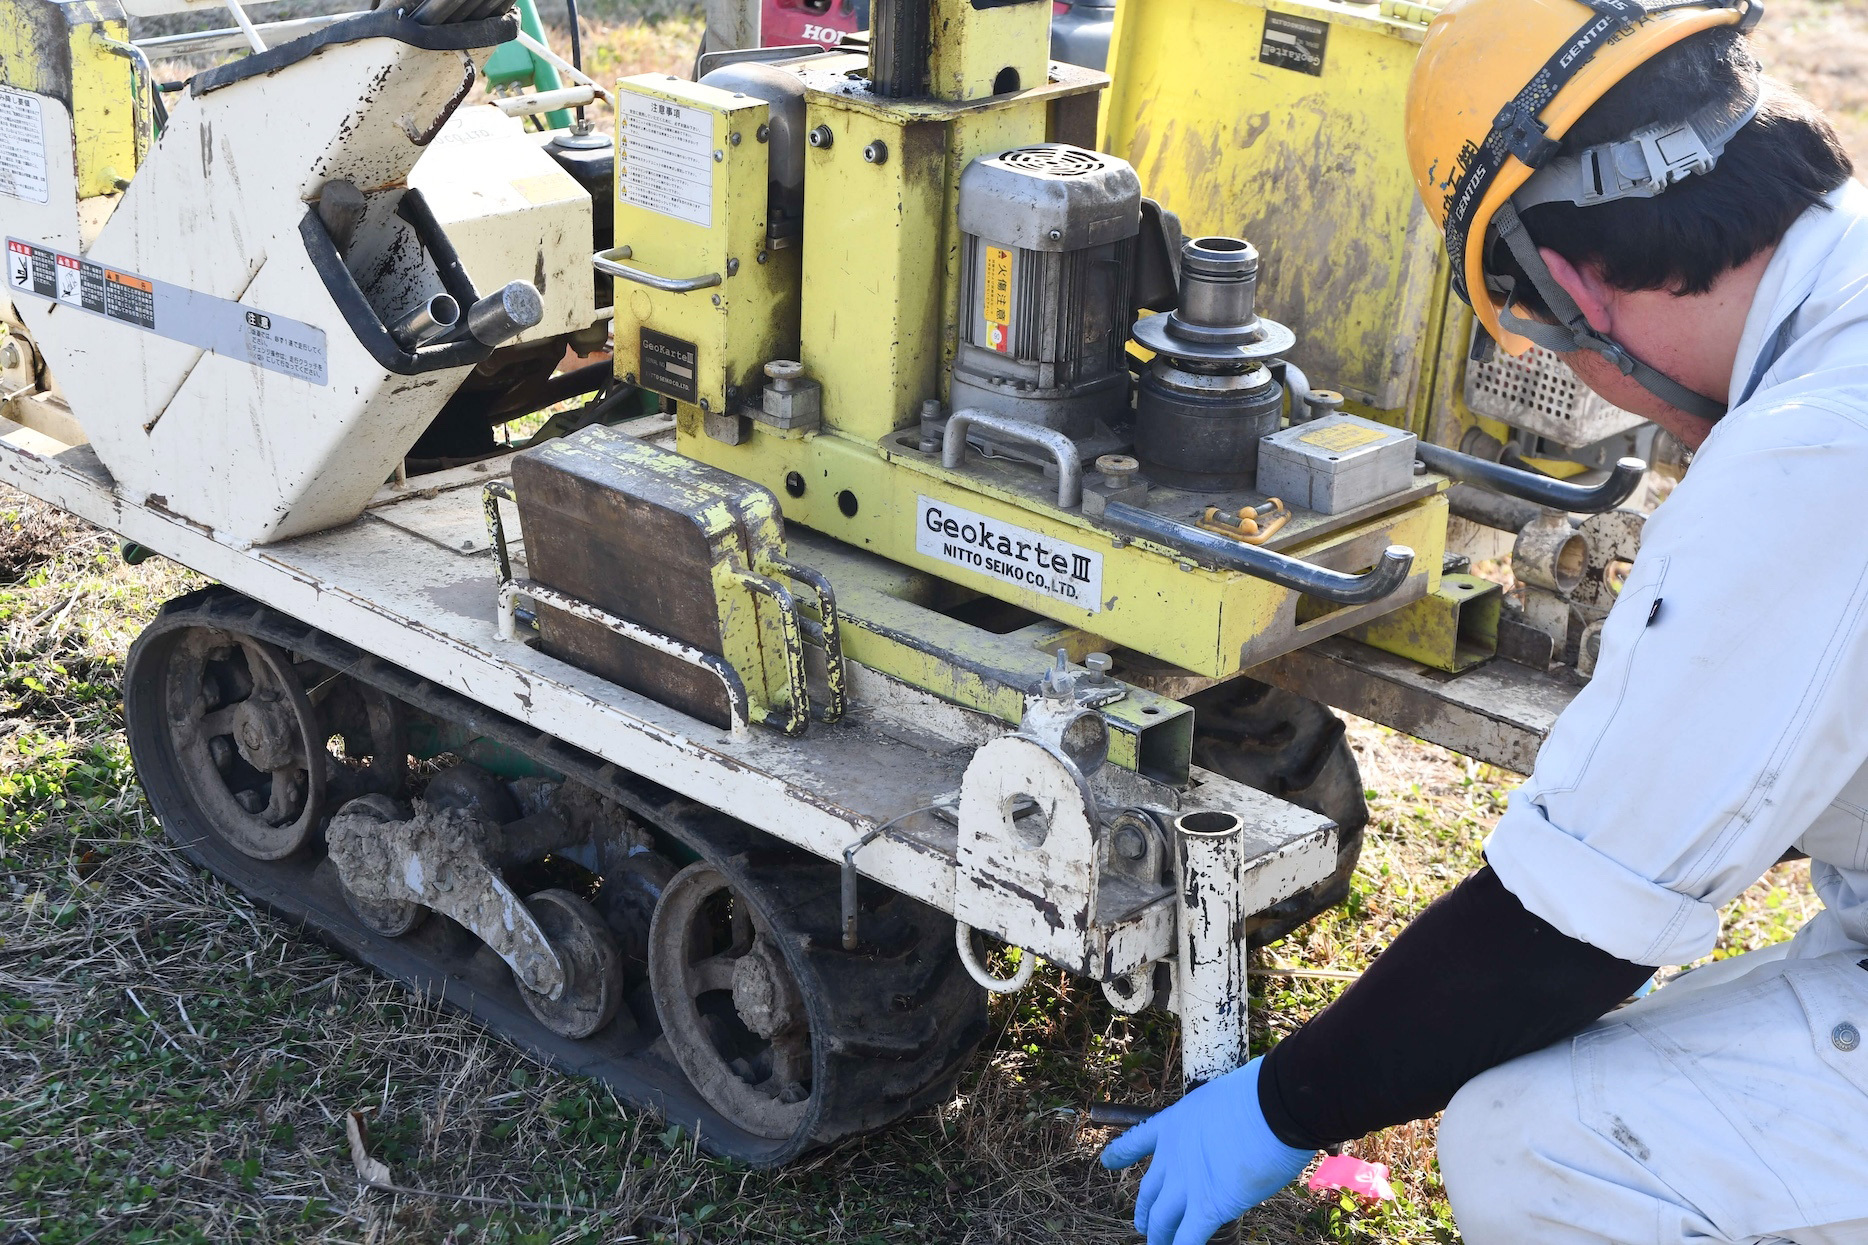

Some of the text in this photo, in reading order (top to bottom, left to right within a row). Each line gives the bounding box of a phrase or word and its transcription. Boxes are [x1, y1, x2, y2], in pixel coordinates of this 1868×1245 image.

[651, 103, 681, 119] 注意事項
[1455, 164, 1487, 221] GENTOS
[944, 543, 1079, 599] NITTO SEIKO CO.,LTD.
